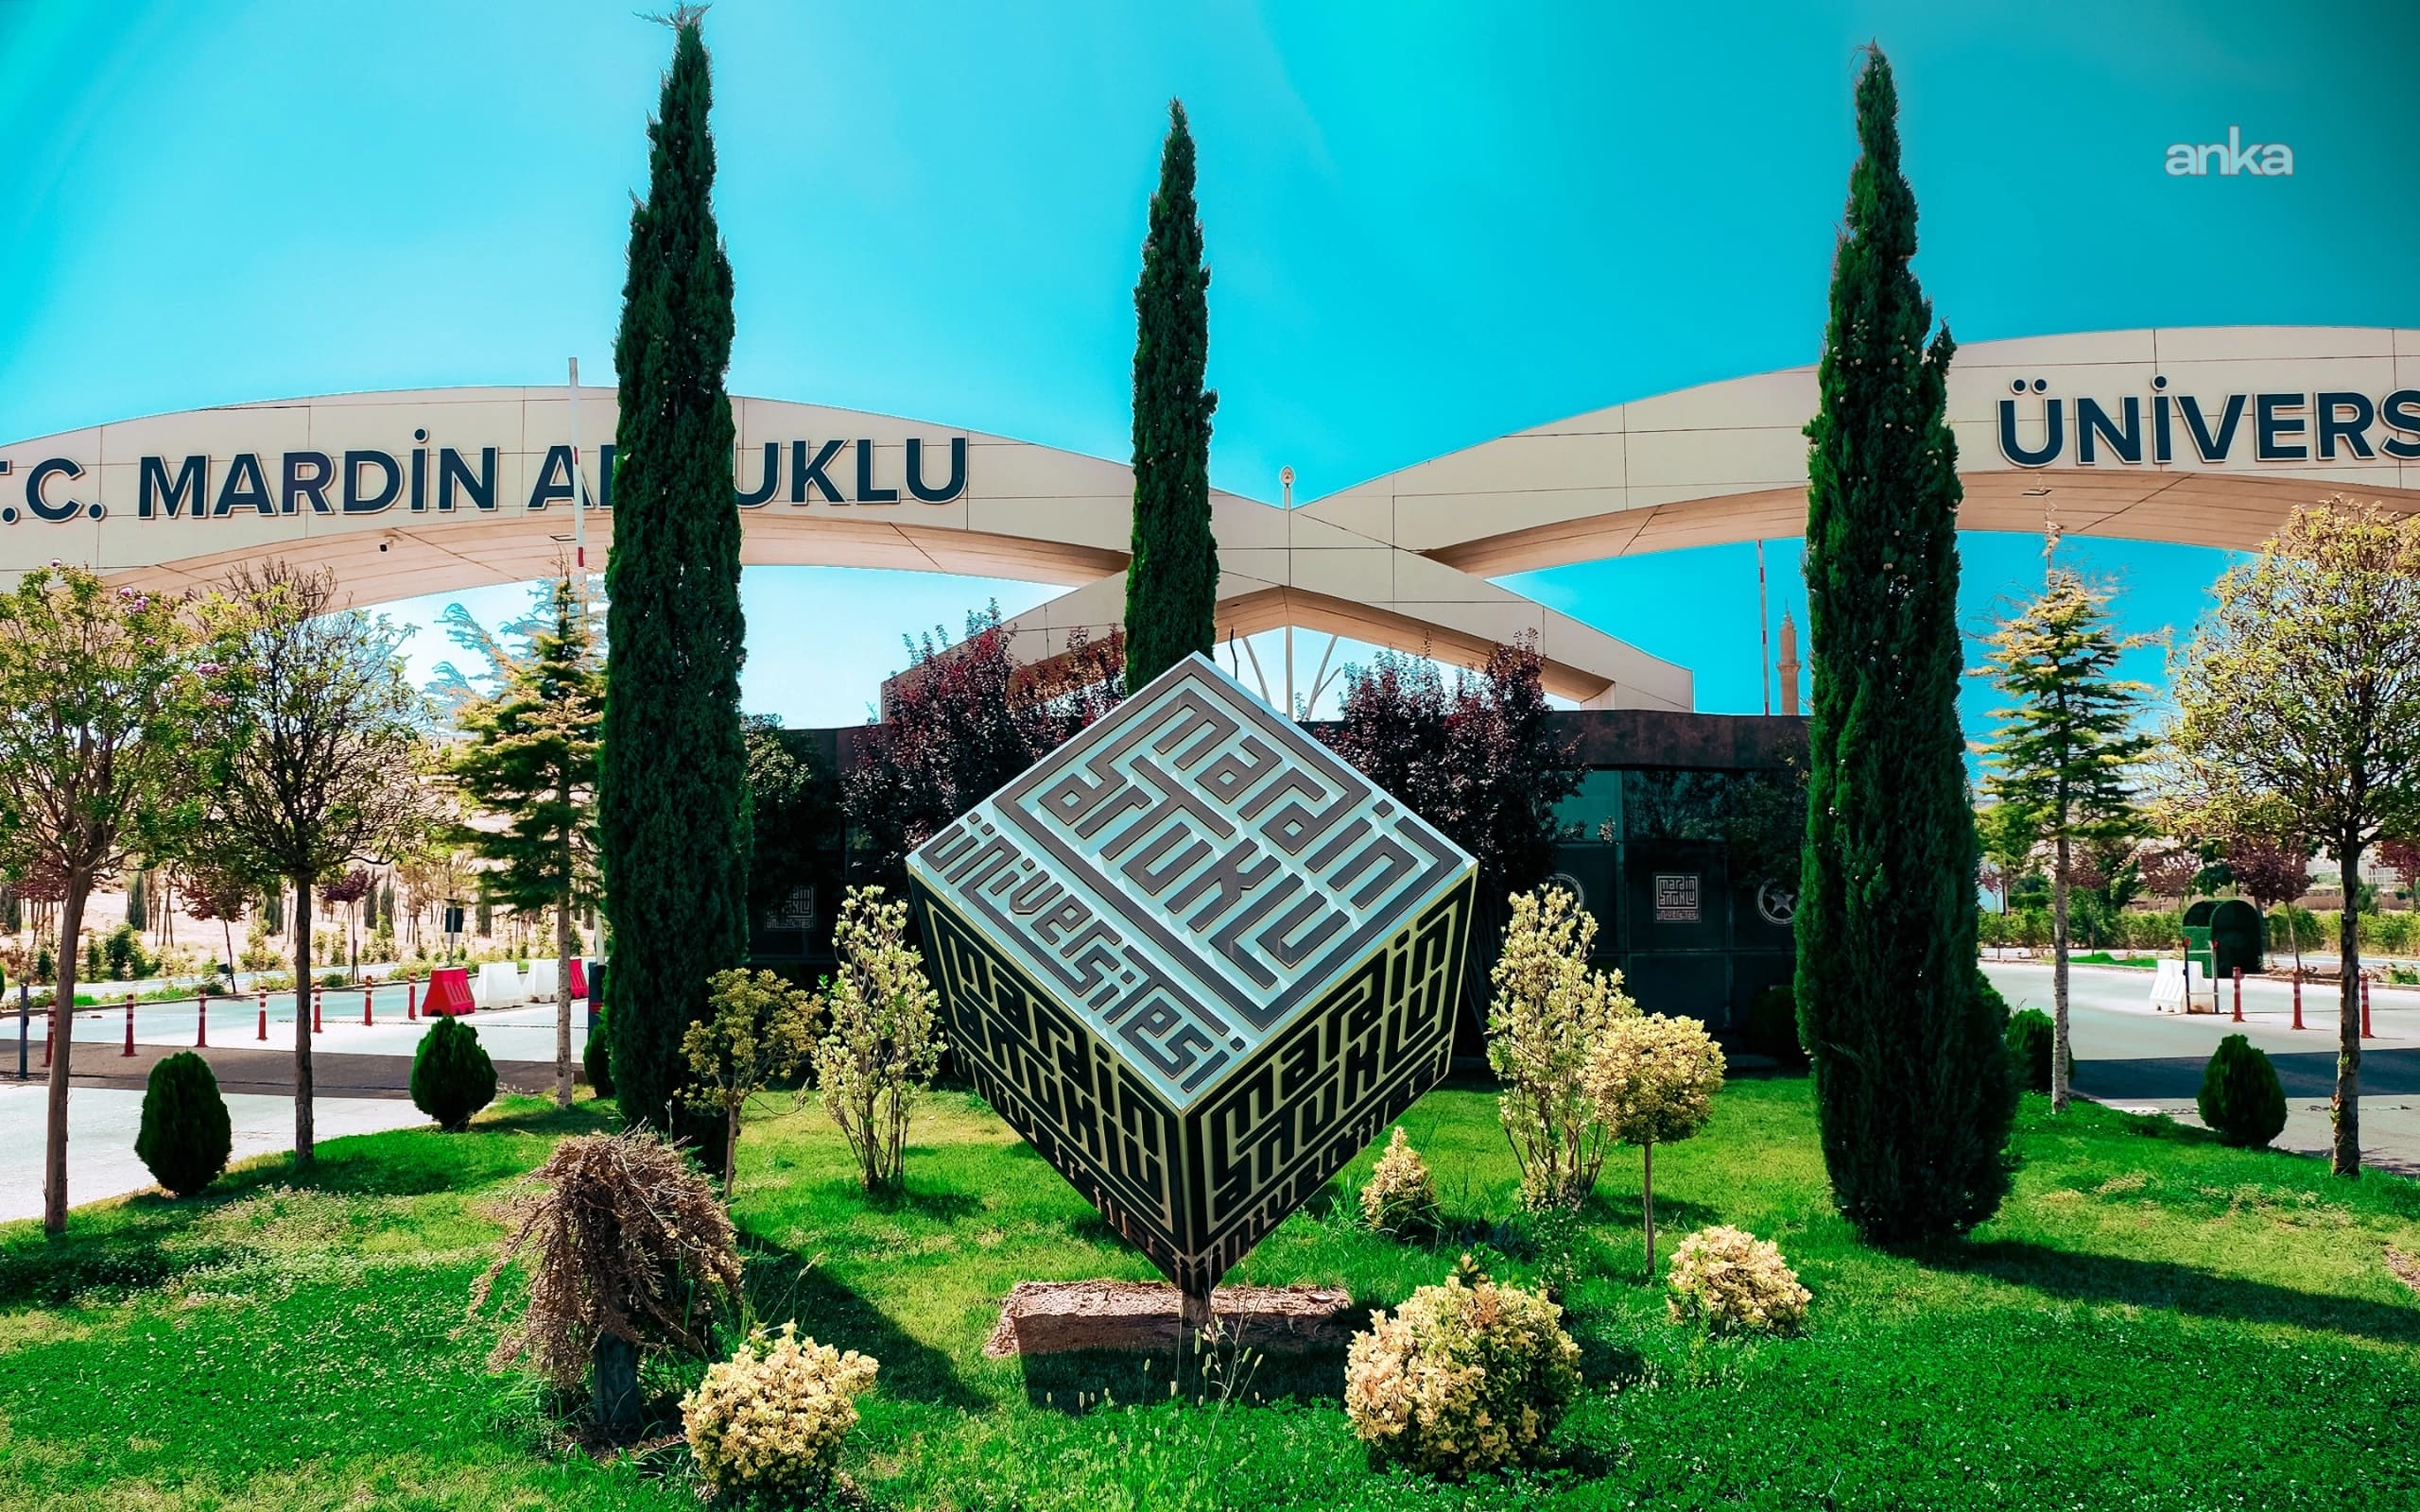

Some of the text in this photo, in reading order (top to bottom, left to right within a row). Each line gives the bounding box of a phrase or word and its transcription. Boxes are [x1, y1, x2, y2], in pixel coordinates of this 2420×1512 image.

[1996, 374, 2420, 468] ÜNİVERS
[0, 428, 970, 524] .C. MARDİN AUKLU
